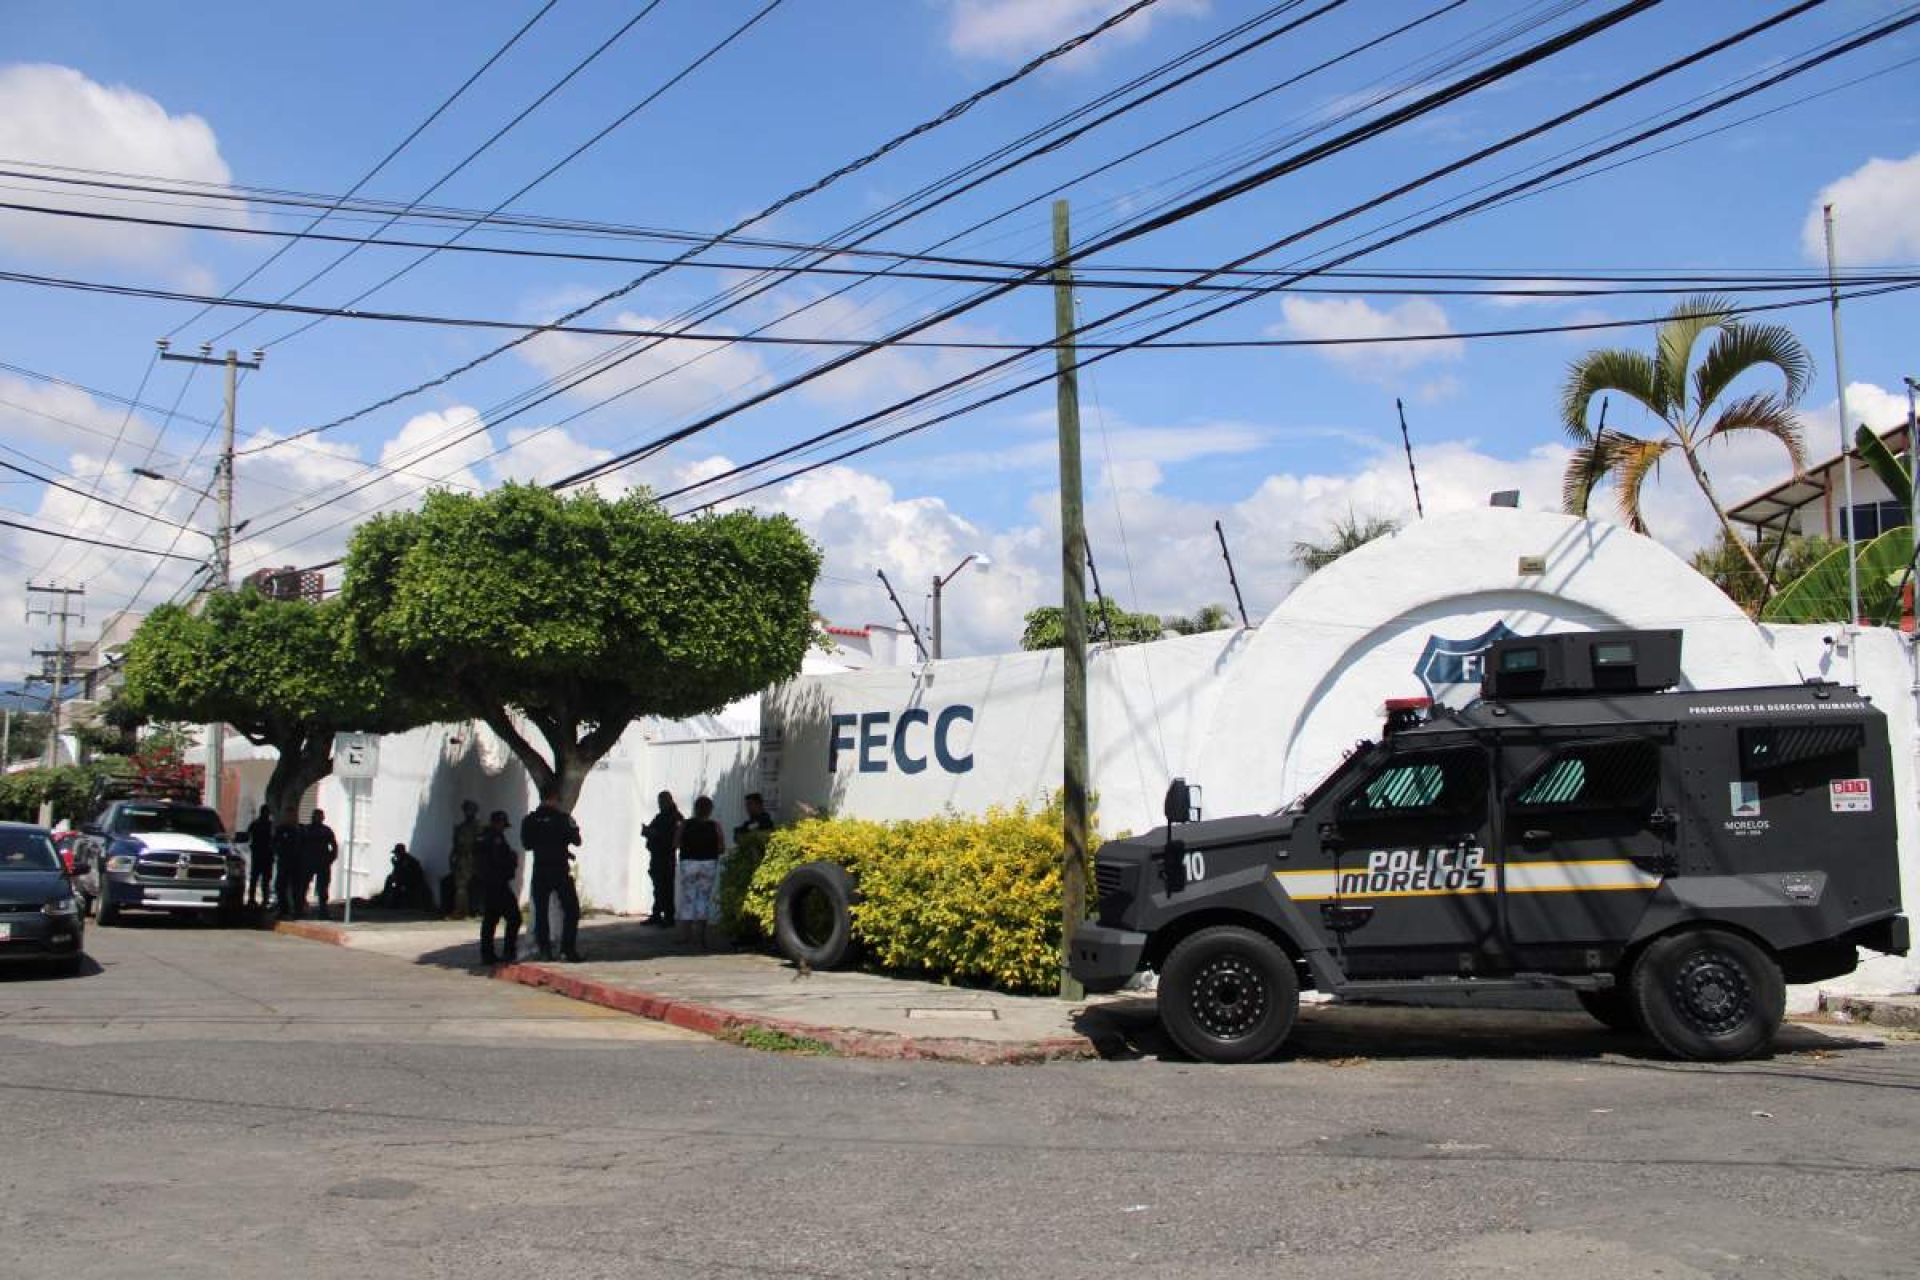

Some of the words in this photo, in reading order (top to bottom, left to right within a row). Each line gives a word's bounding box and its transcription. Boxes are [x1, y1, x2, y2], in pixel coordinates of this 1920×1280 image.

[1818, 701, 1867, 711] HUMANOS
[828, 704, 974, 775] FECC
[1724, 820, 1771, 830] MORELOS
[1182, 851, 1205, 882] 10
